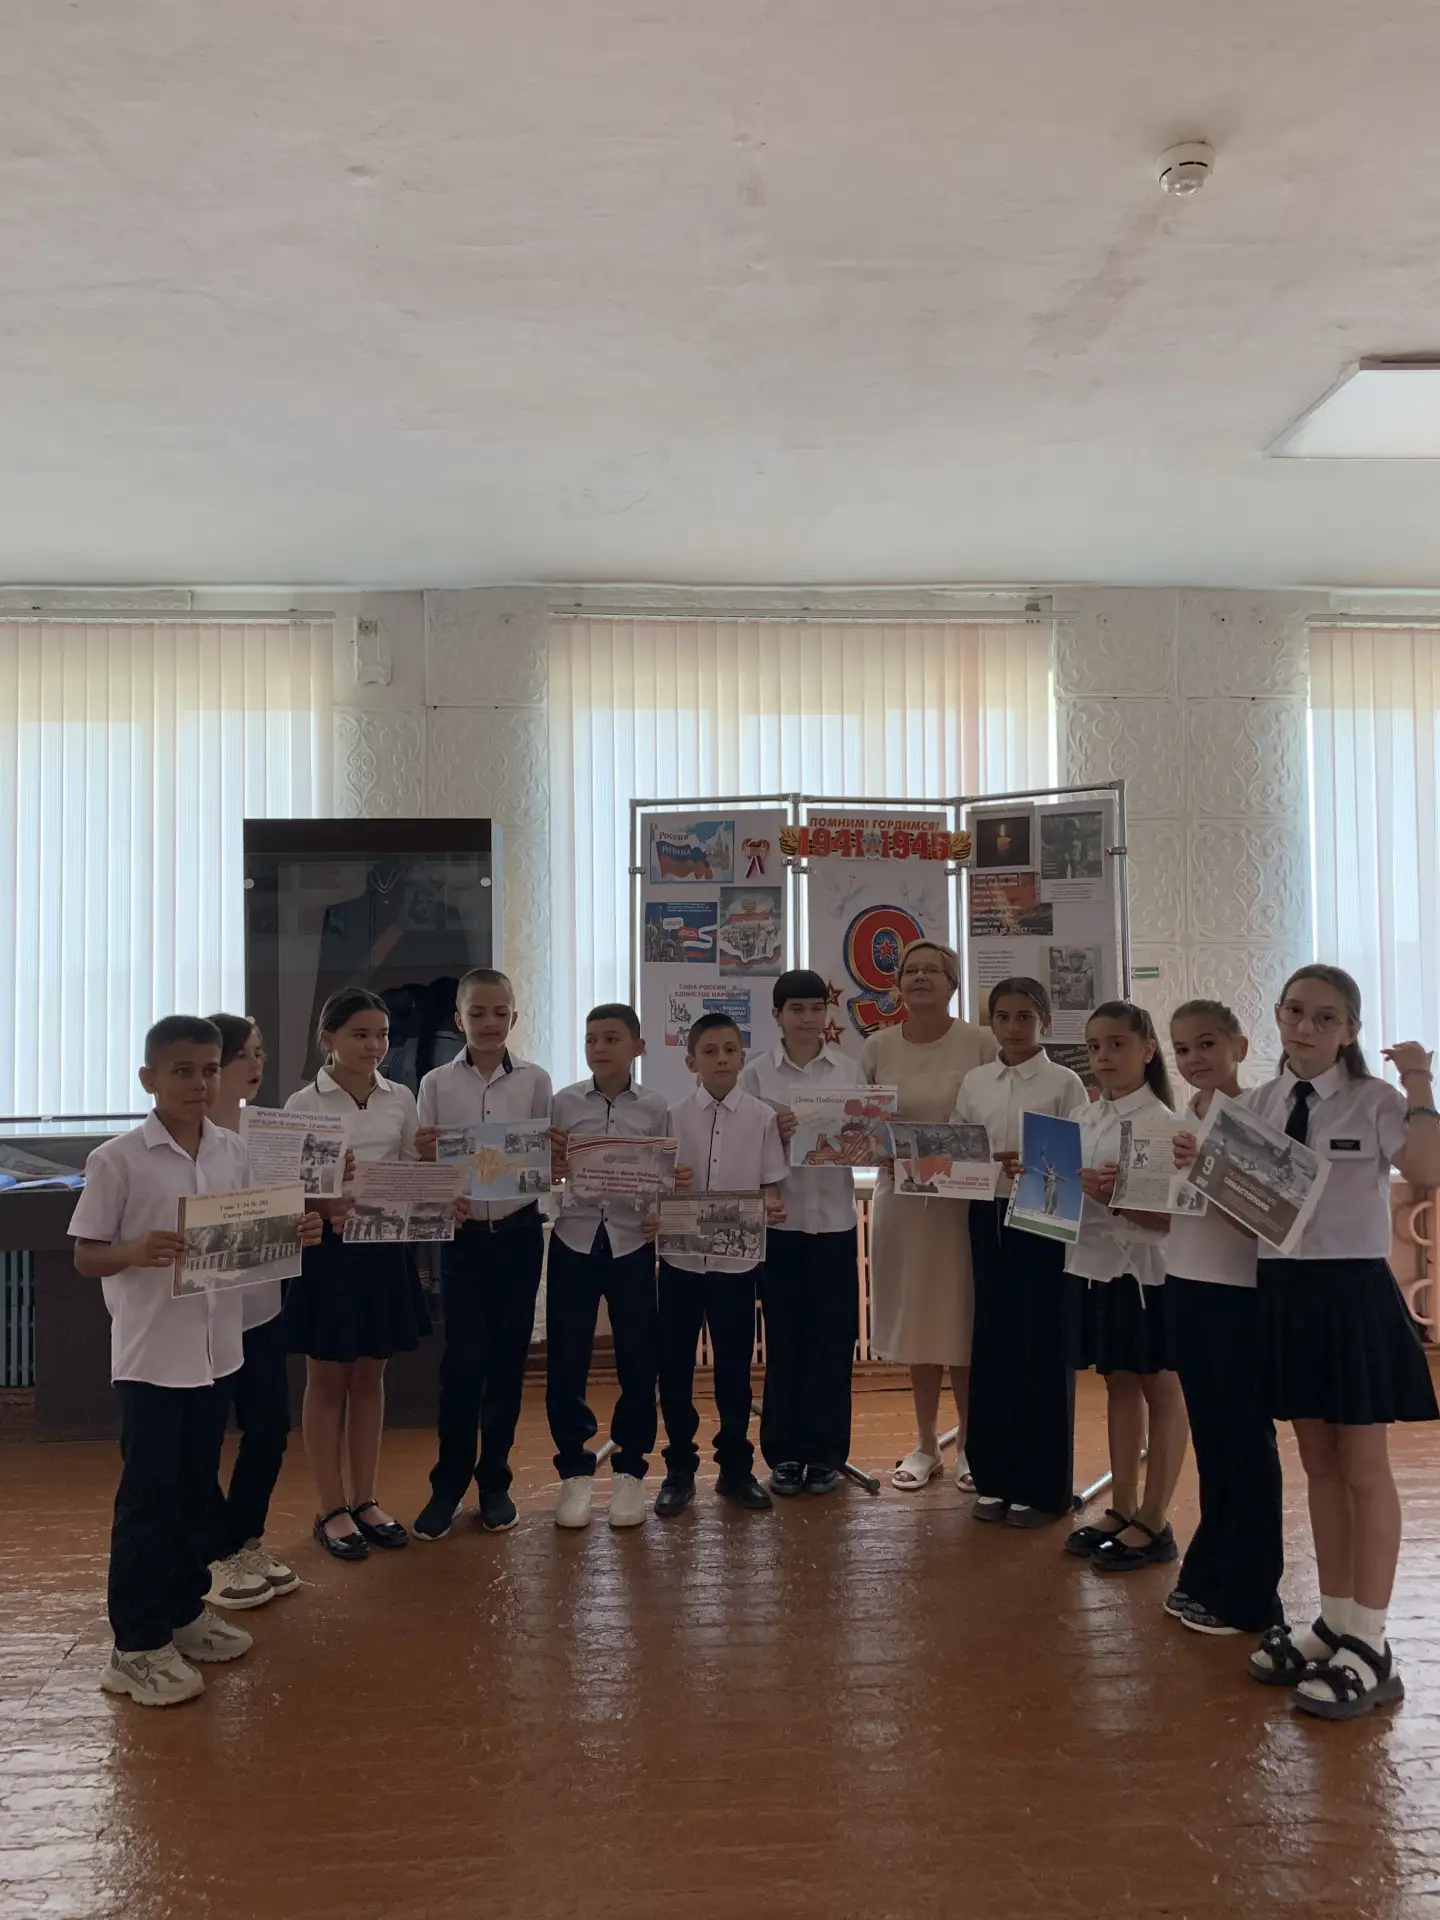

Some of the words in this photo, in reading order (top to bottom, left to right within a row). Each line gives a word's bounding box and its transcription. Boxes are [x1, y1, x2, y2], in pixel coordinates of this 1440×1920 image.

[810, 817, 869, 828] ПОМНИМ!
[873, 819, 940, 831] ГОРДИМСЯ!
[800, 828, 865, 857] 1941
[880, 830, 951, 860] 1945
[843, 904, 926, 1037] 9
[816, 1096, 845, 1104] Победы
[1202, 1156, 1215, 1175] 9
[1224, 1177, 1271, 1212] СЕВАСТОПОЛЯ
